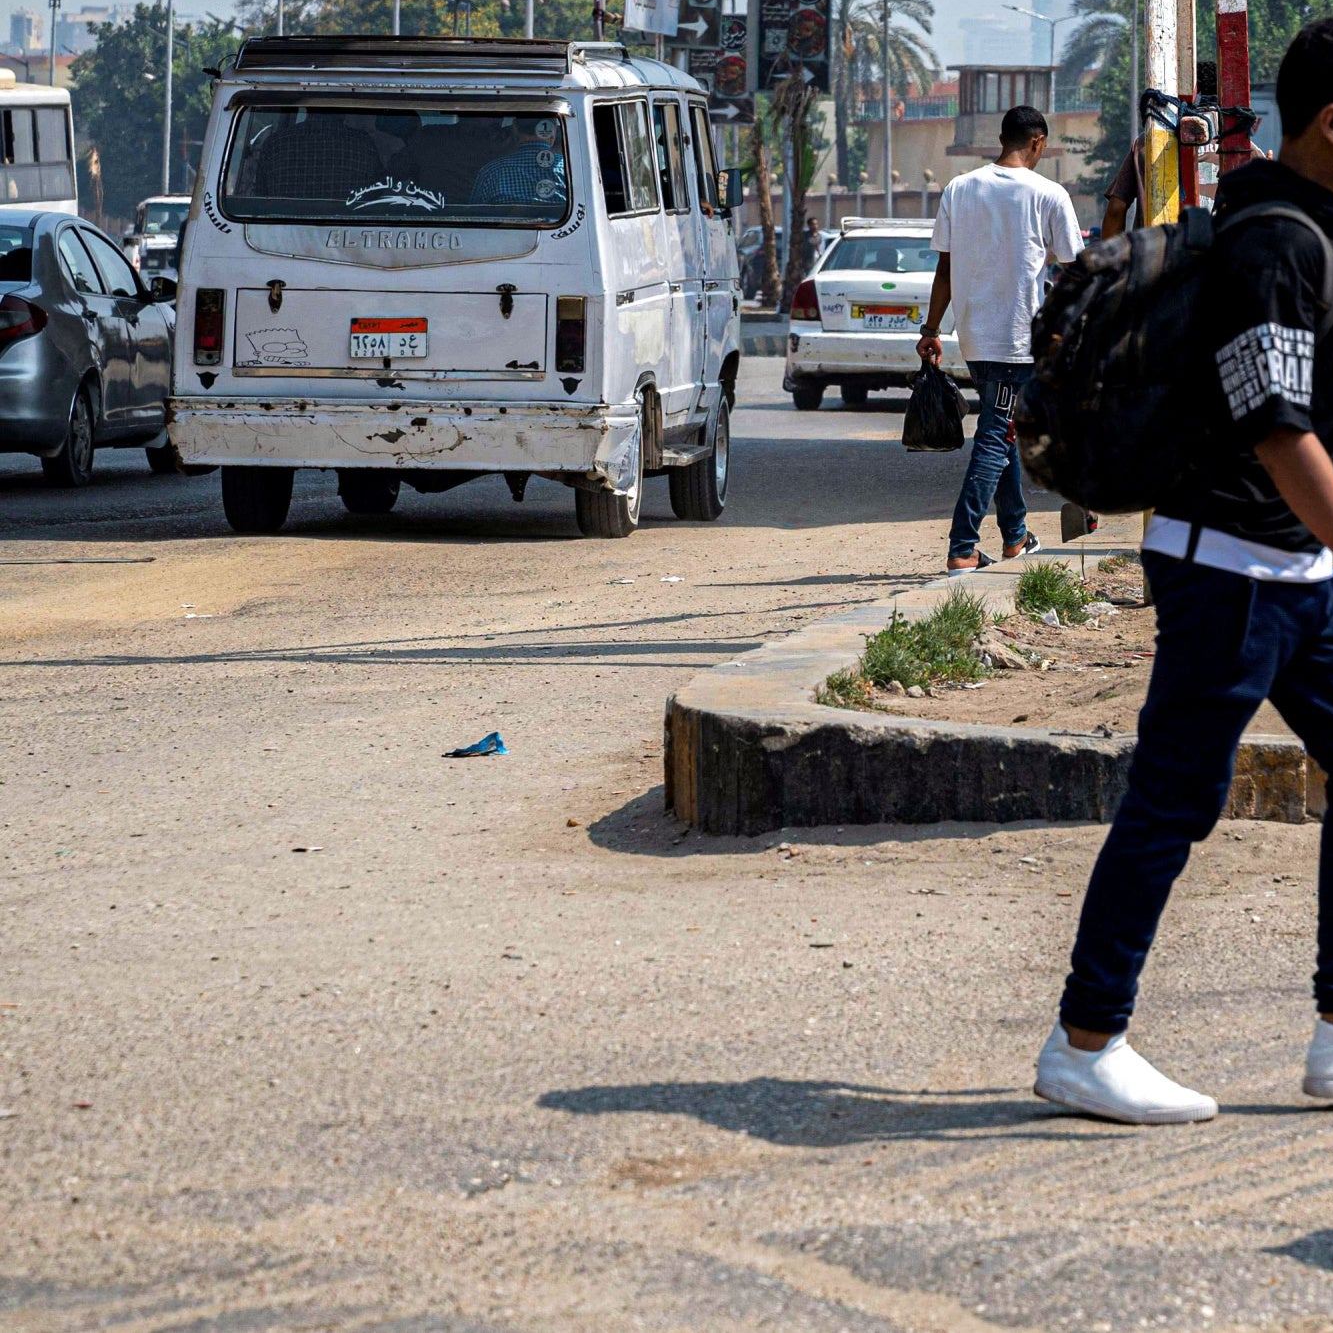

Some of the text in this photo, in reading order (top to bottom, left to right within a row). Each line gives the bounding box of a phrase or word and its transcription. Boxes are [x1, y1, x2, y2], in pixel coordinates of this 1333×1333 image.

[405, 180, 445, 209] الحسن
[551, 203, 586, 240] يوسف
[326, 230, 463, 250] ELTRAMCO
